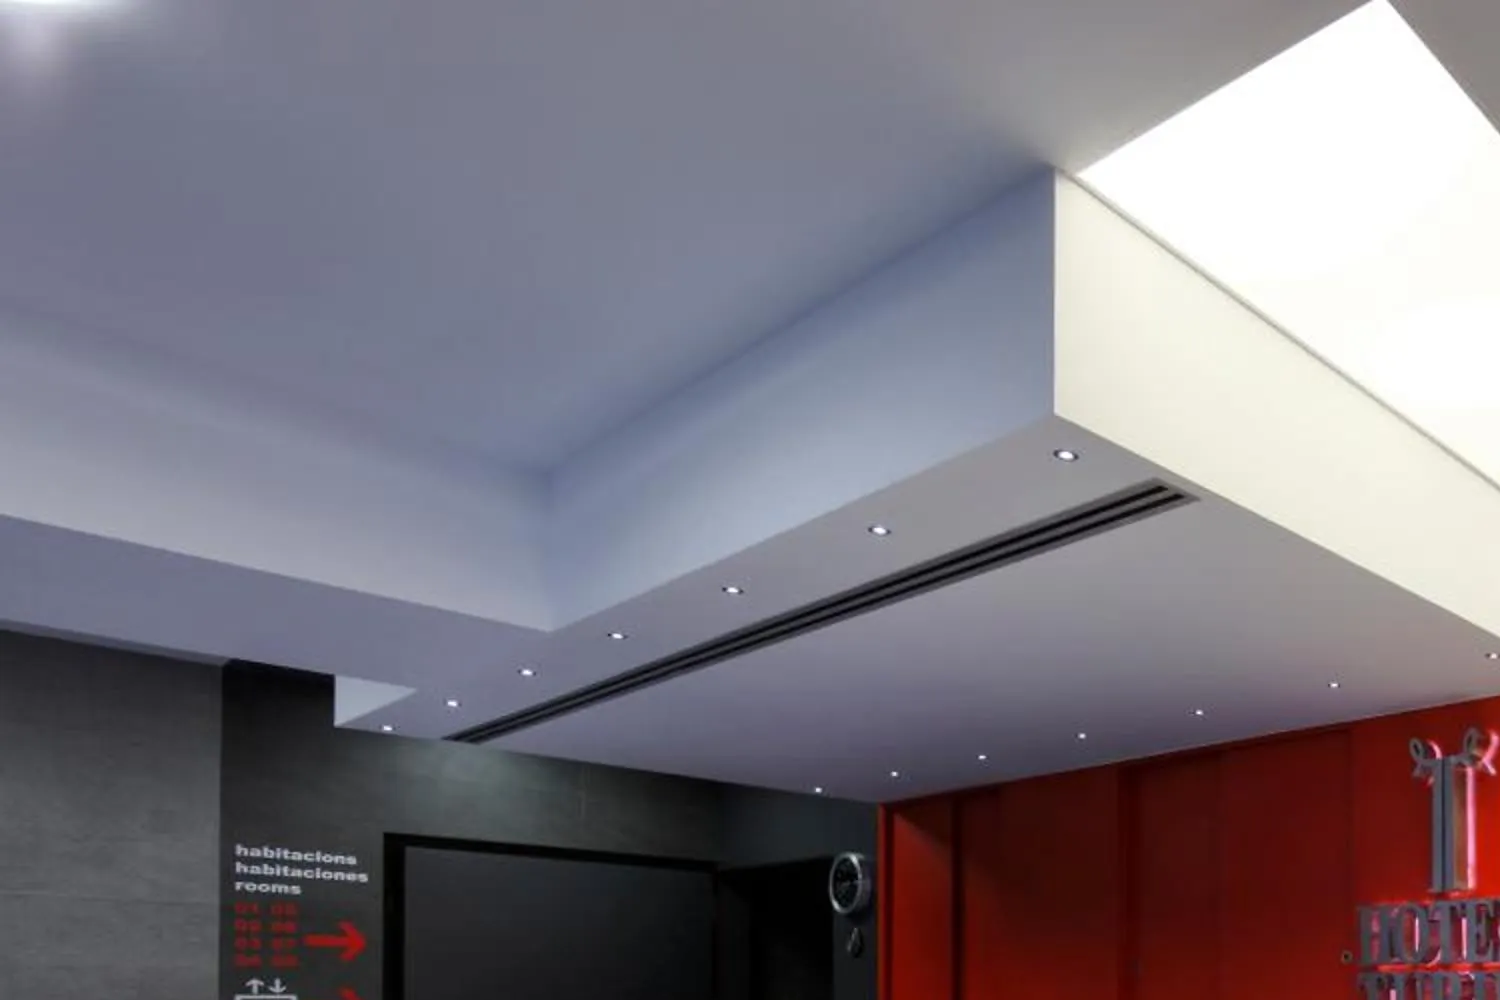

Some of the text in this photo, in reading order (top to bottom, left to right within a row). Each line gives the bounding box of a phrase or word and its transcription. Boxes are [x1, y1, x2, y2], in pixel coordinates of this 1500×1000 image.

[234, 844, 357, 865] habitacions
[234, 861, 369, 883] habitaciones
[234, 880, 302, 895] rooms
